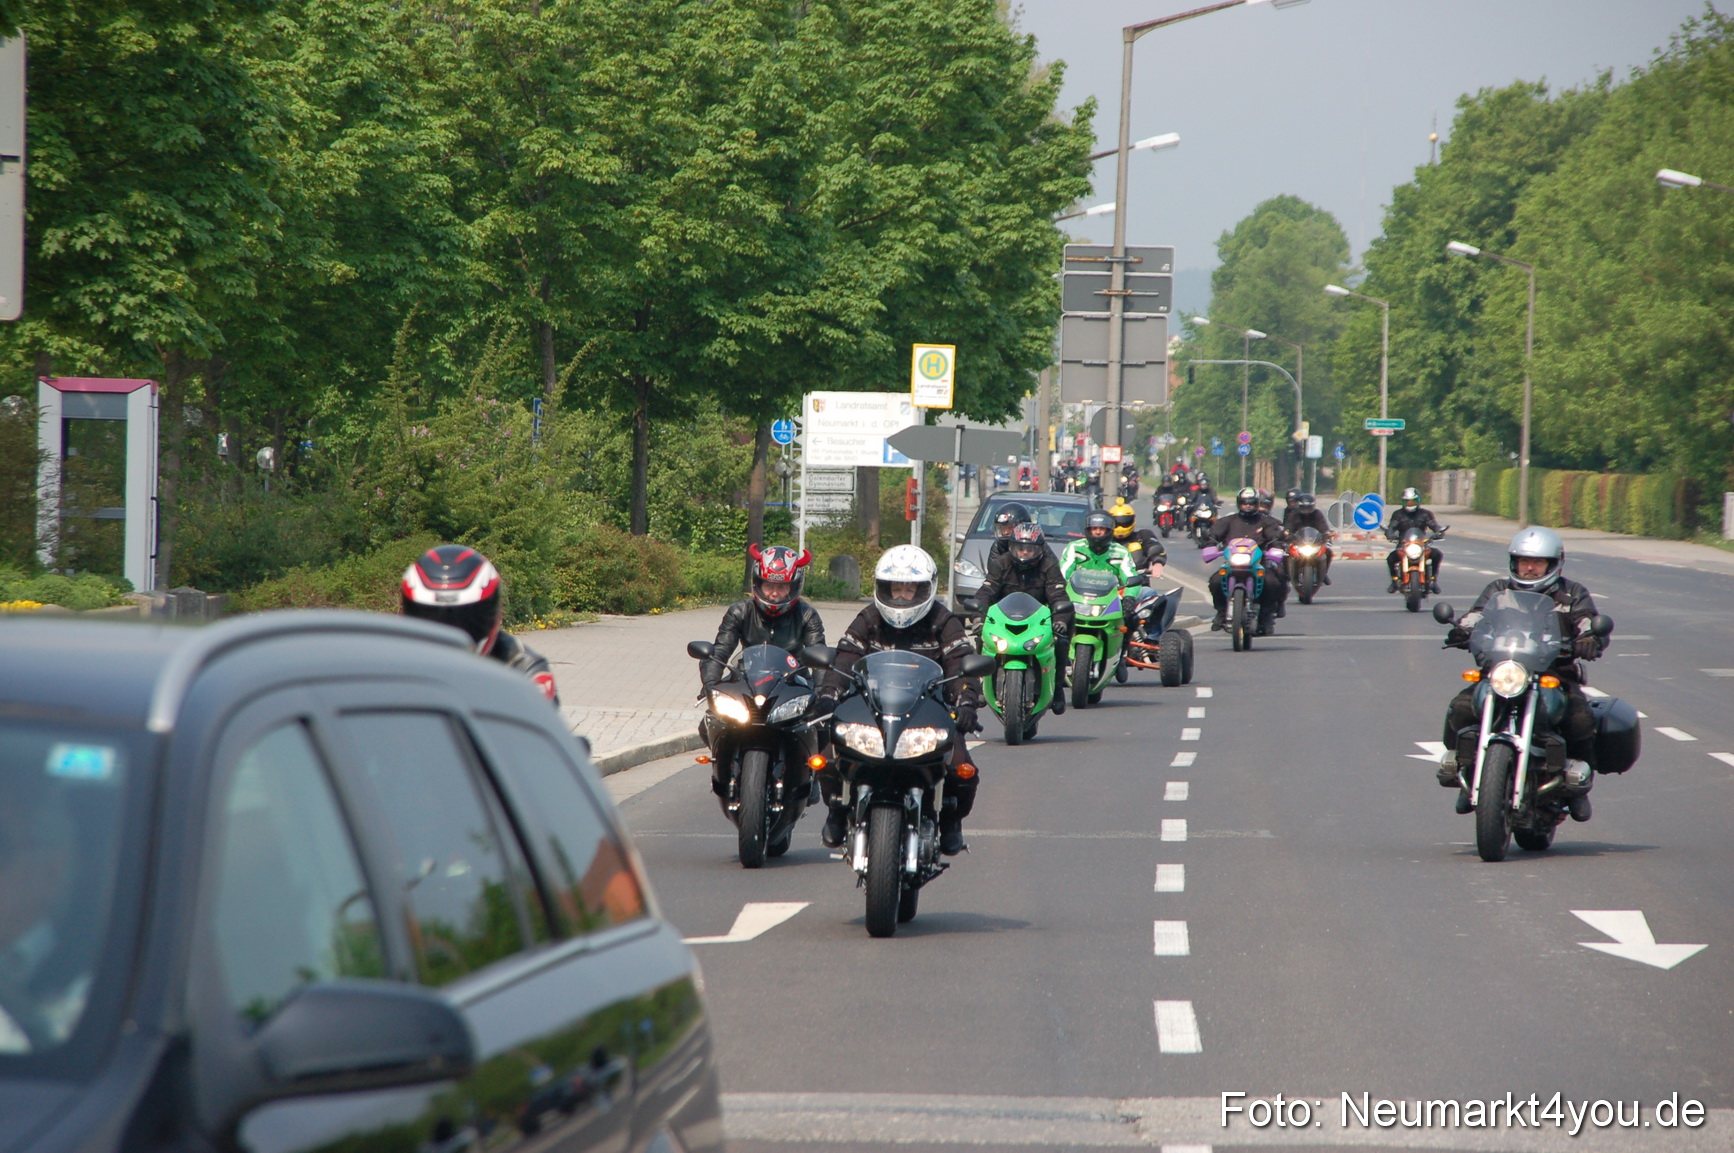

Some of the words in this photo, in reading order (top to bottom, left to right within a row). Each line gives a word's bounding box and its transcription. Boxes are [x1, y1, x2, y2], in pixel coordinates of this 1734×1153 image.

[927, 357, 941, 373] H
[835, 401, 888, 410] Landratsamt
[818, 419, 858, 427] Neumarkt
[827, 437, 866, 446] Besucher
